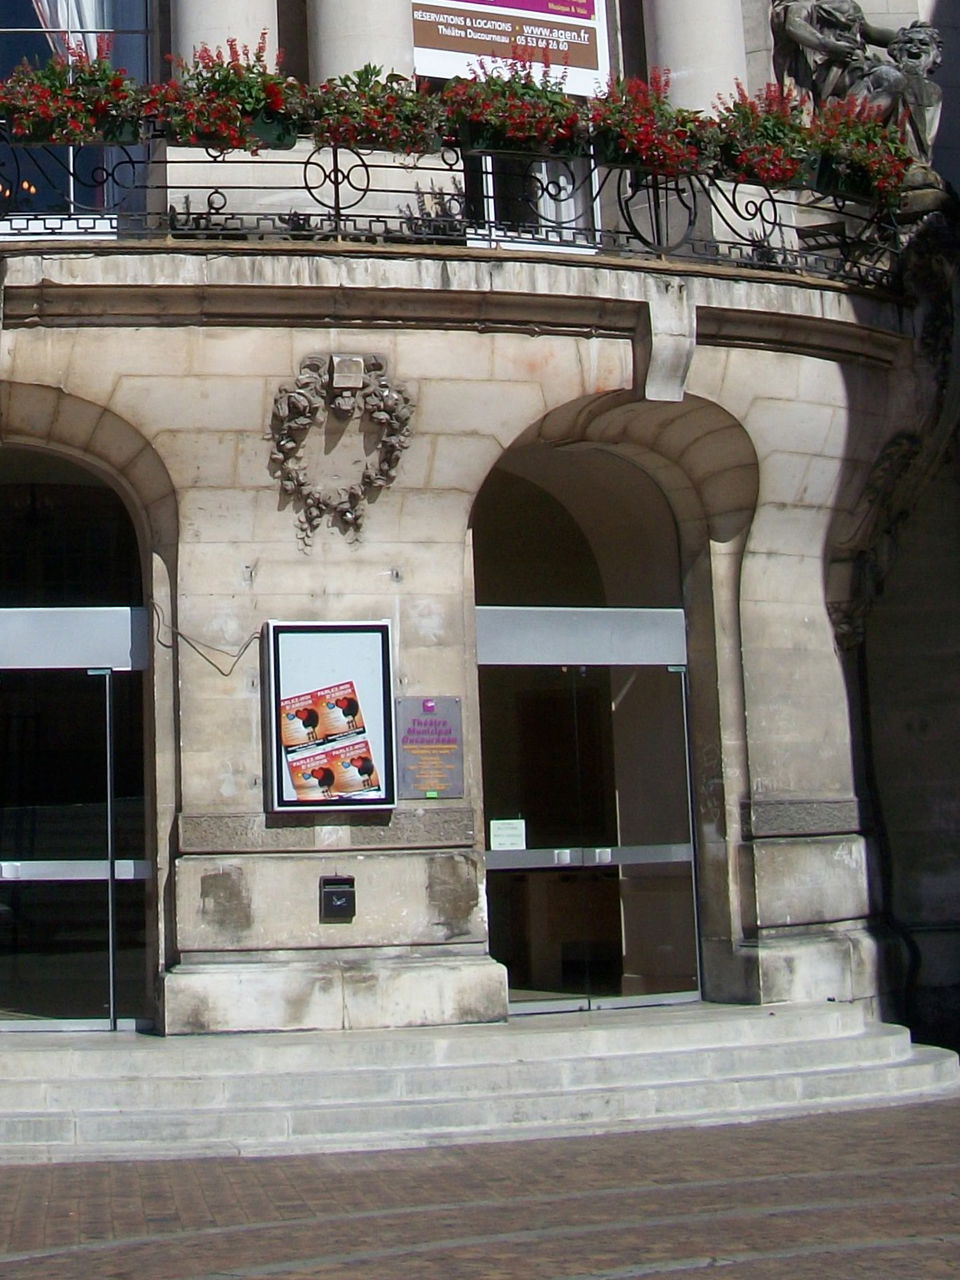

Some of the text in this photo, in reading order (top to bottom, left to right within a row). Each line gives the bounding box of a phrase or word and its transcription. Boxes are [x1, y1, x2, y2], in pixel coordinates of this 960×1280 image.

[413, 10, 590, 43] RÉSERVATIONS & LOCATIONS www.agen.fr
[467, 28, 510, 43] Ducourneau
[516, 36, 526, 46] 05
[527, 37, 537, 47] 53
